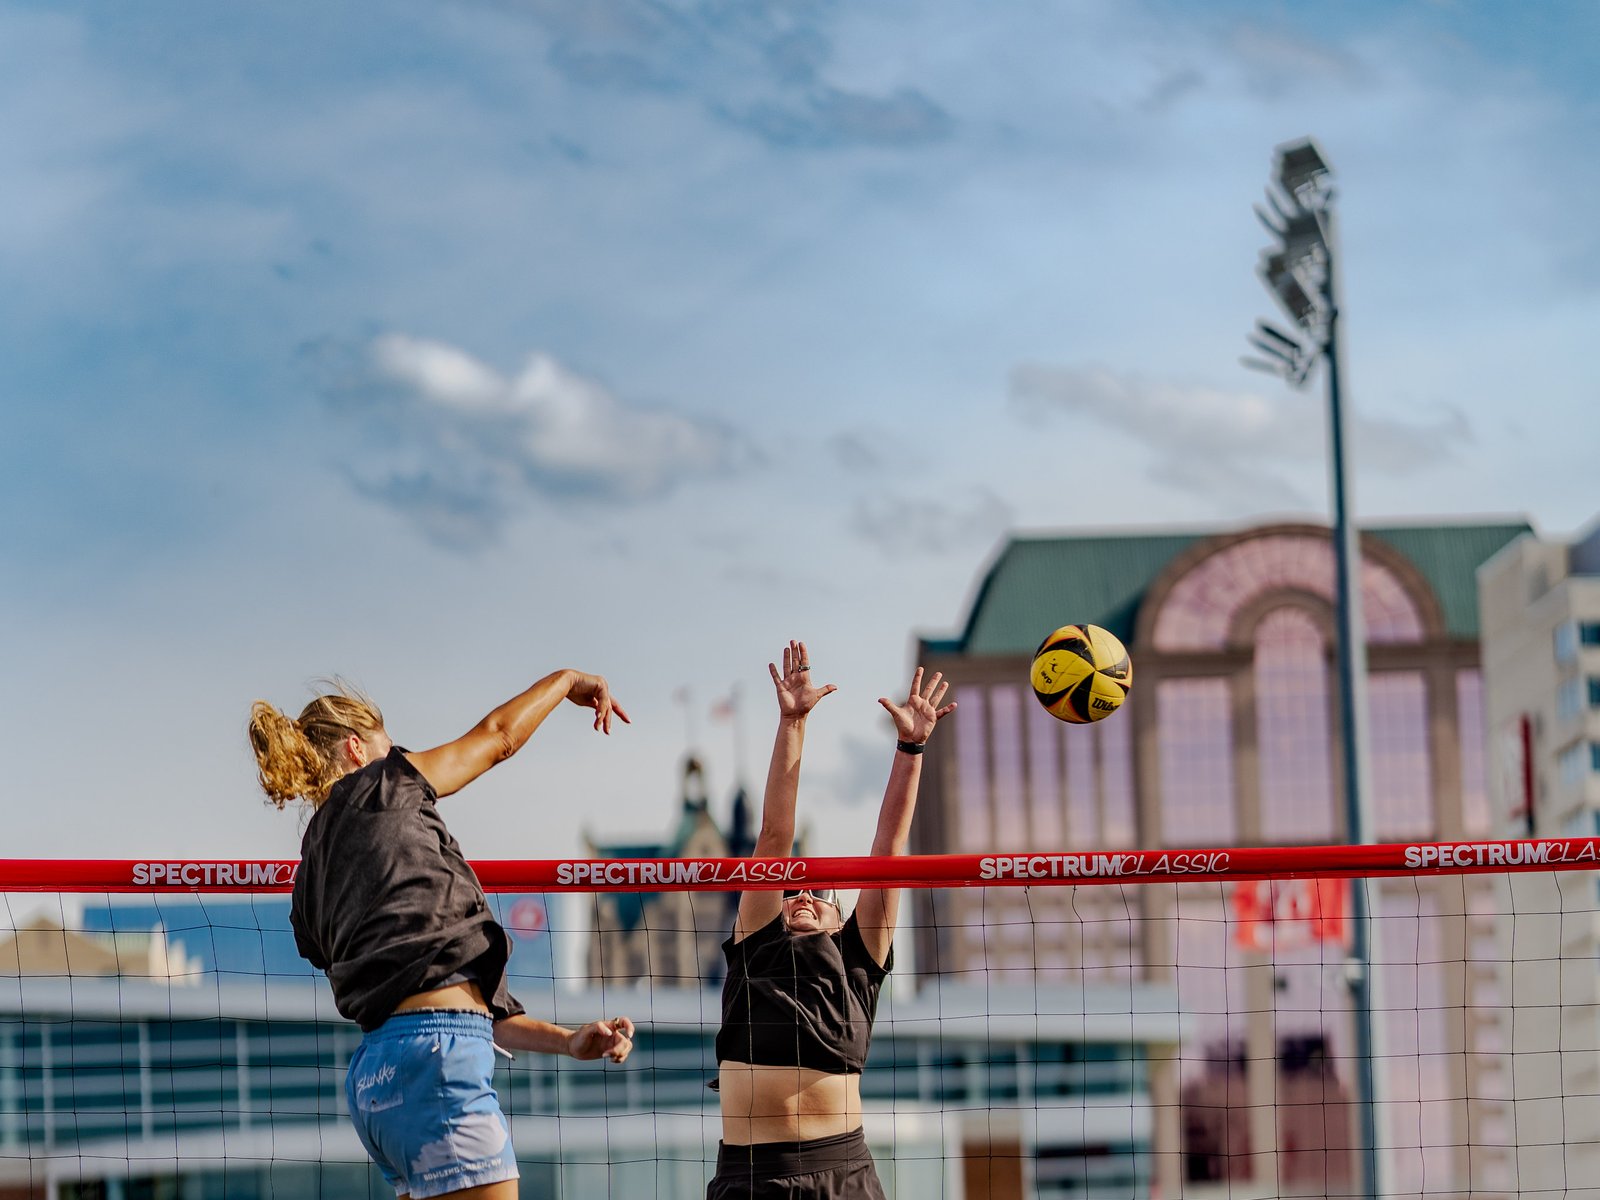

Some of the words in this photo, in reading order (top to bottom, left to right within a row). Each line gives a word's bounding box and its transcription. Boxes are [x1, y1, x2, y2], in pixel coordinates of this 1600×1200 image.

[979, 855, 1122, 879] SPECTRUM
[1120, 853, 1230, 875] CLASSIC
[1404, 842, 1547, 868] SPECTRUM
[132, 863, 276, 885] SPECTRUM
[556, 862, 698, 885] SPECTRUM
[696, 861, 807, 882] CLASSIC
